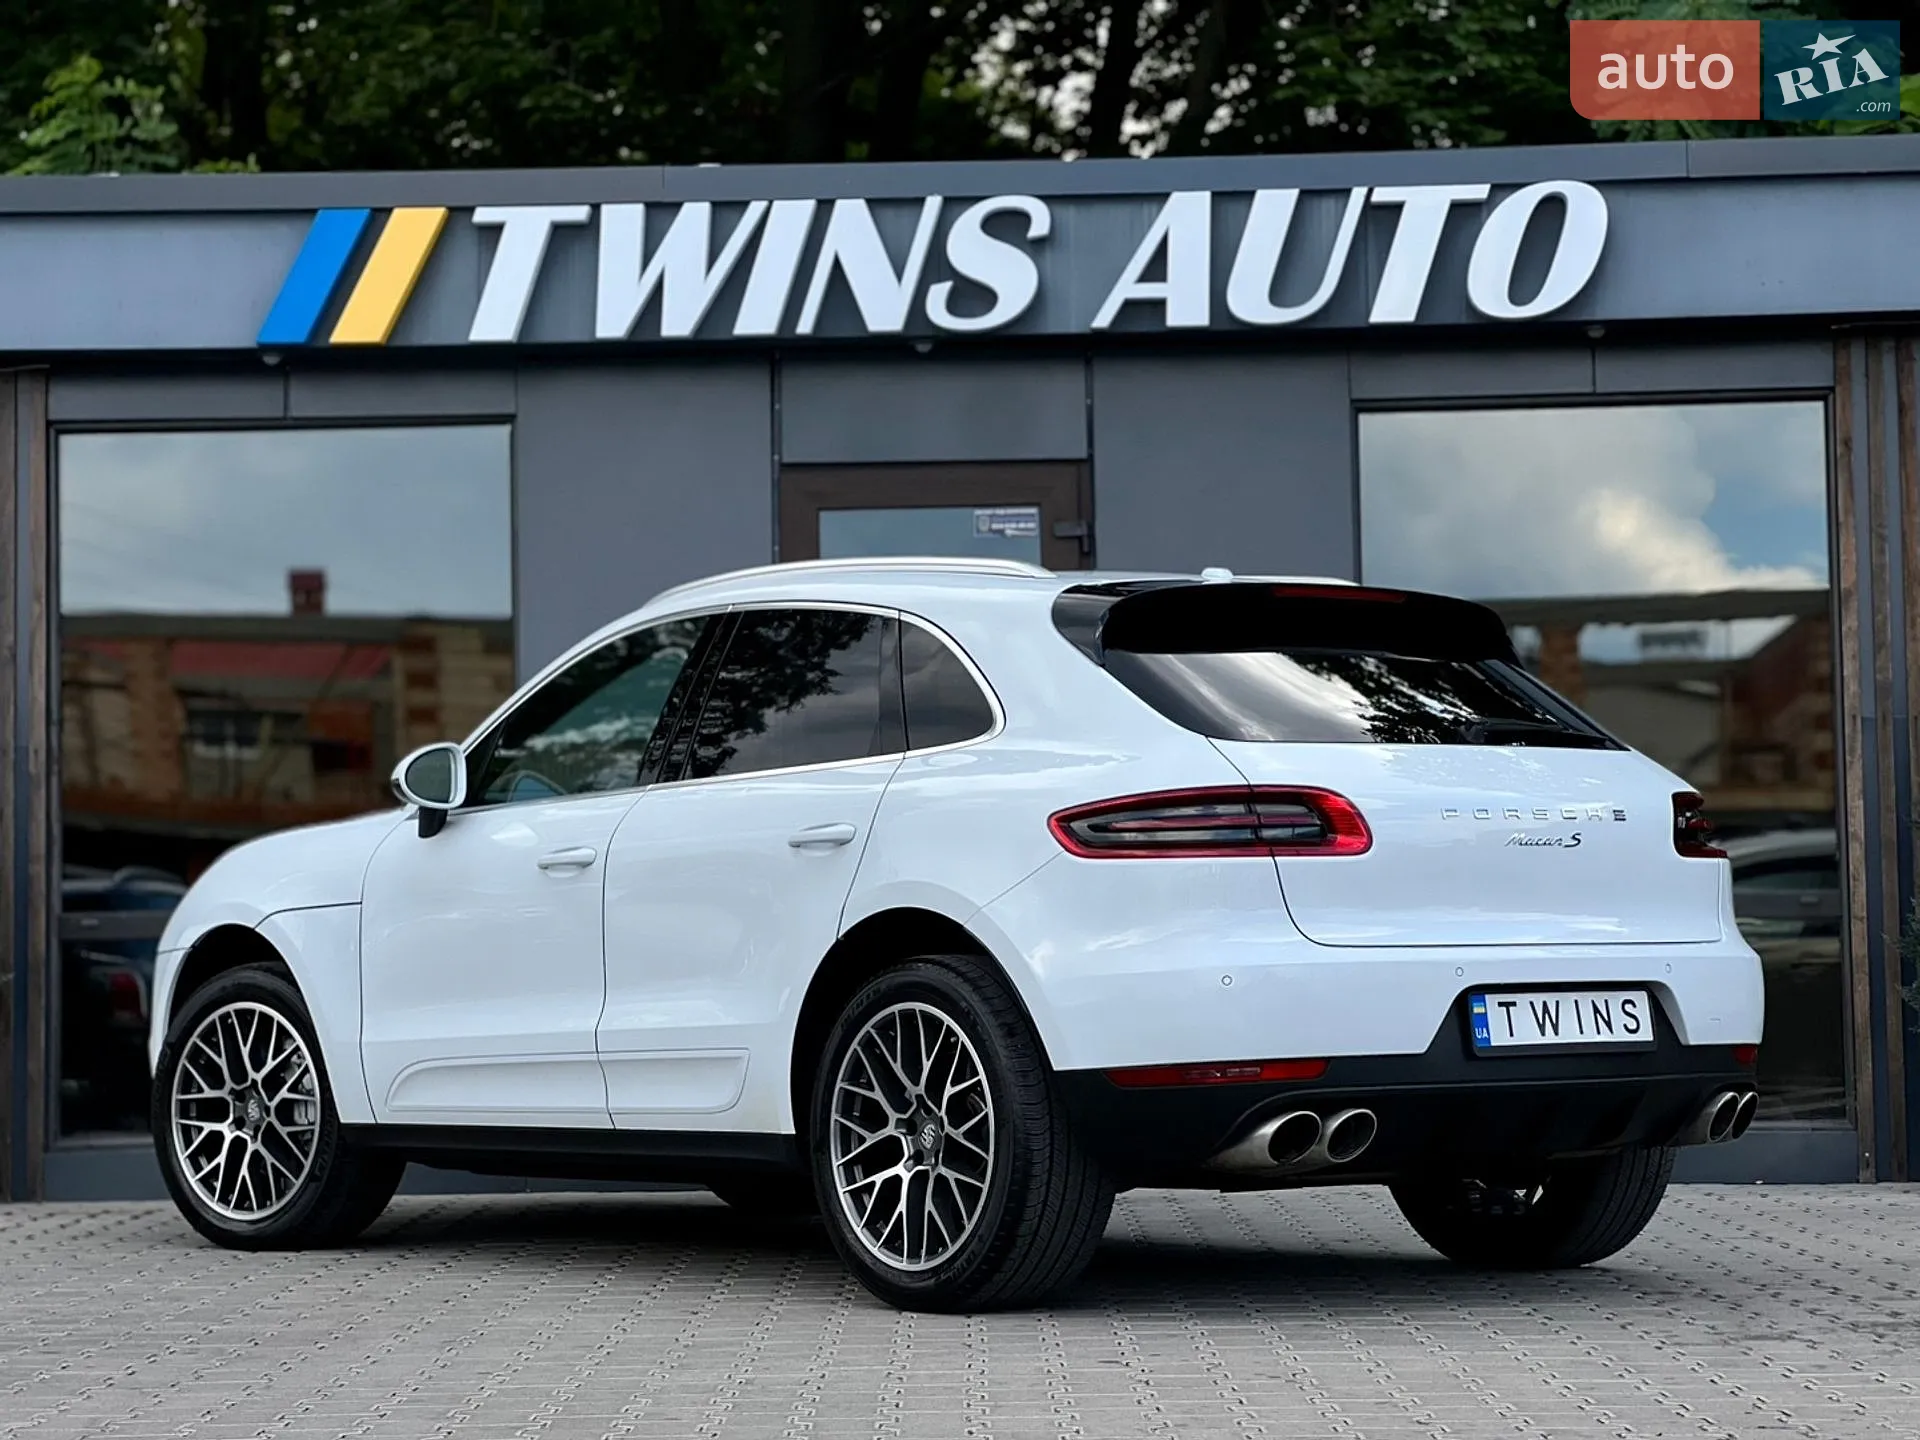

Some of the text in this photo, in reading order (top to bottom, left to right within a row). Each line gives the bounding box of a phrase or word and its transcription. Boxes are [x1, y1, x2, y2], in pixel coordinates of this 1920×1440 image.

[468, 180, 1608, 342] TWINS AUTO
[1441, 807, 1627, 822] PORSCHE
[1504, 832, 1582, 848] Macan S
[1498, 999, 1640, 1038] TWINS
[1475, 1027, 1489, 1039] UA
